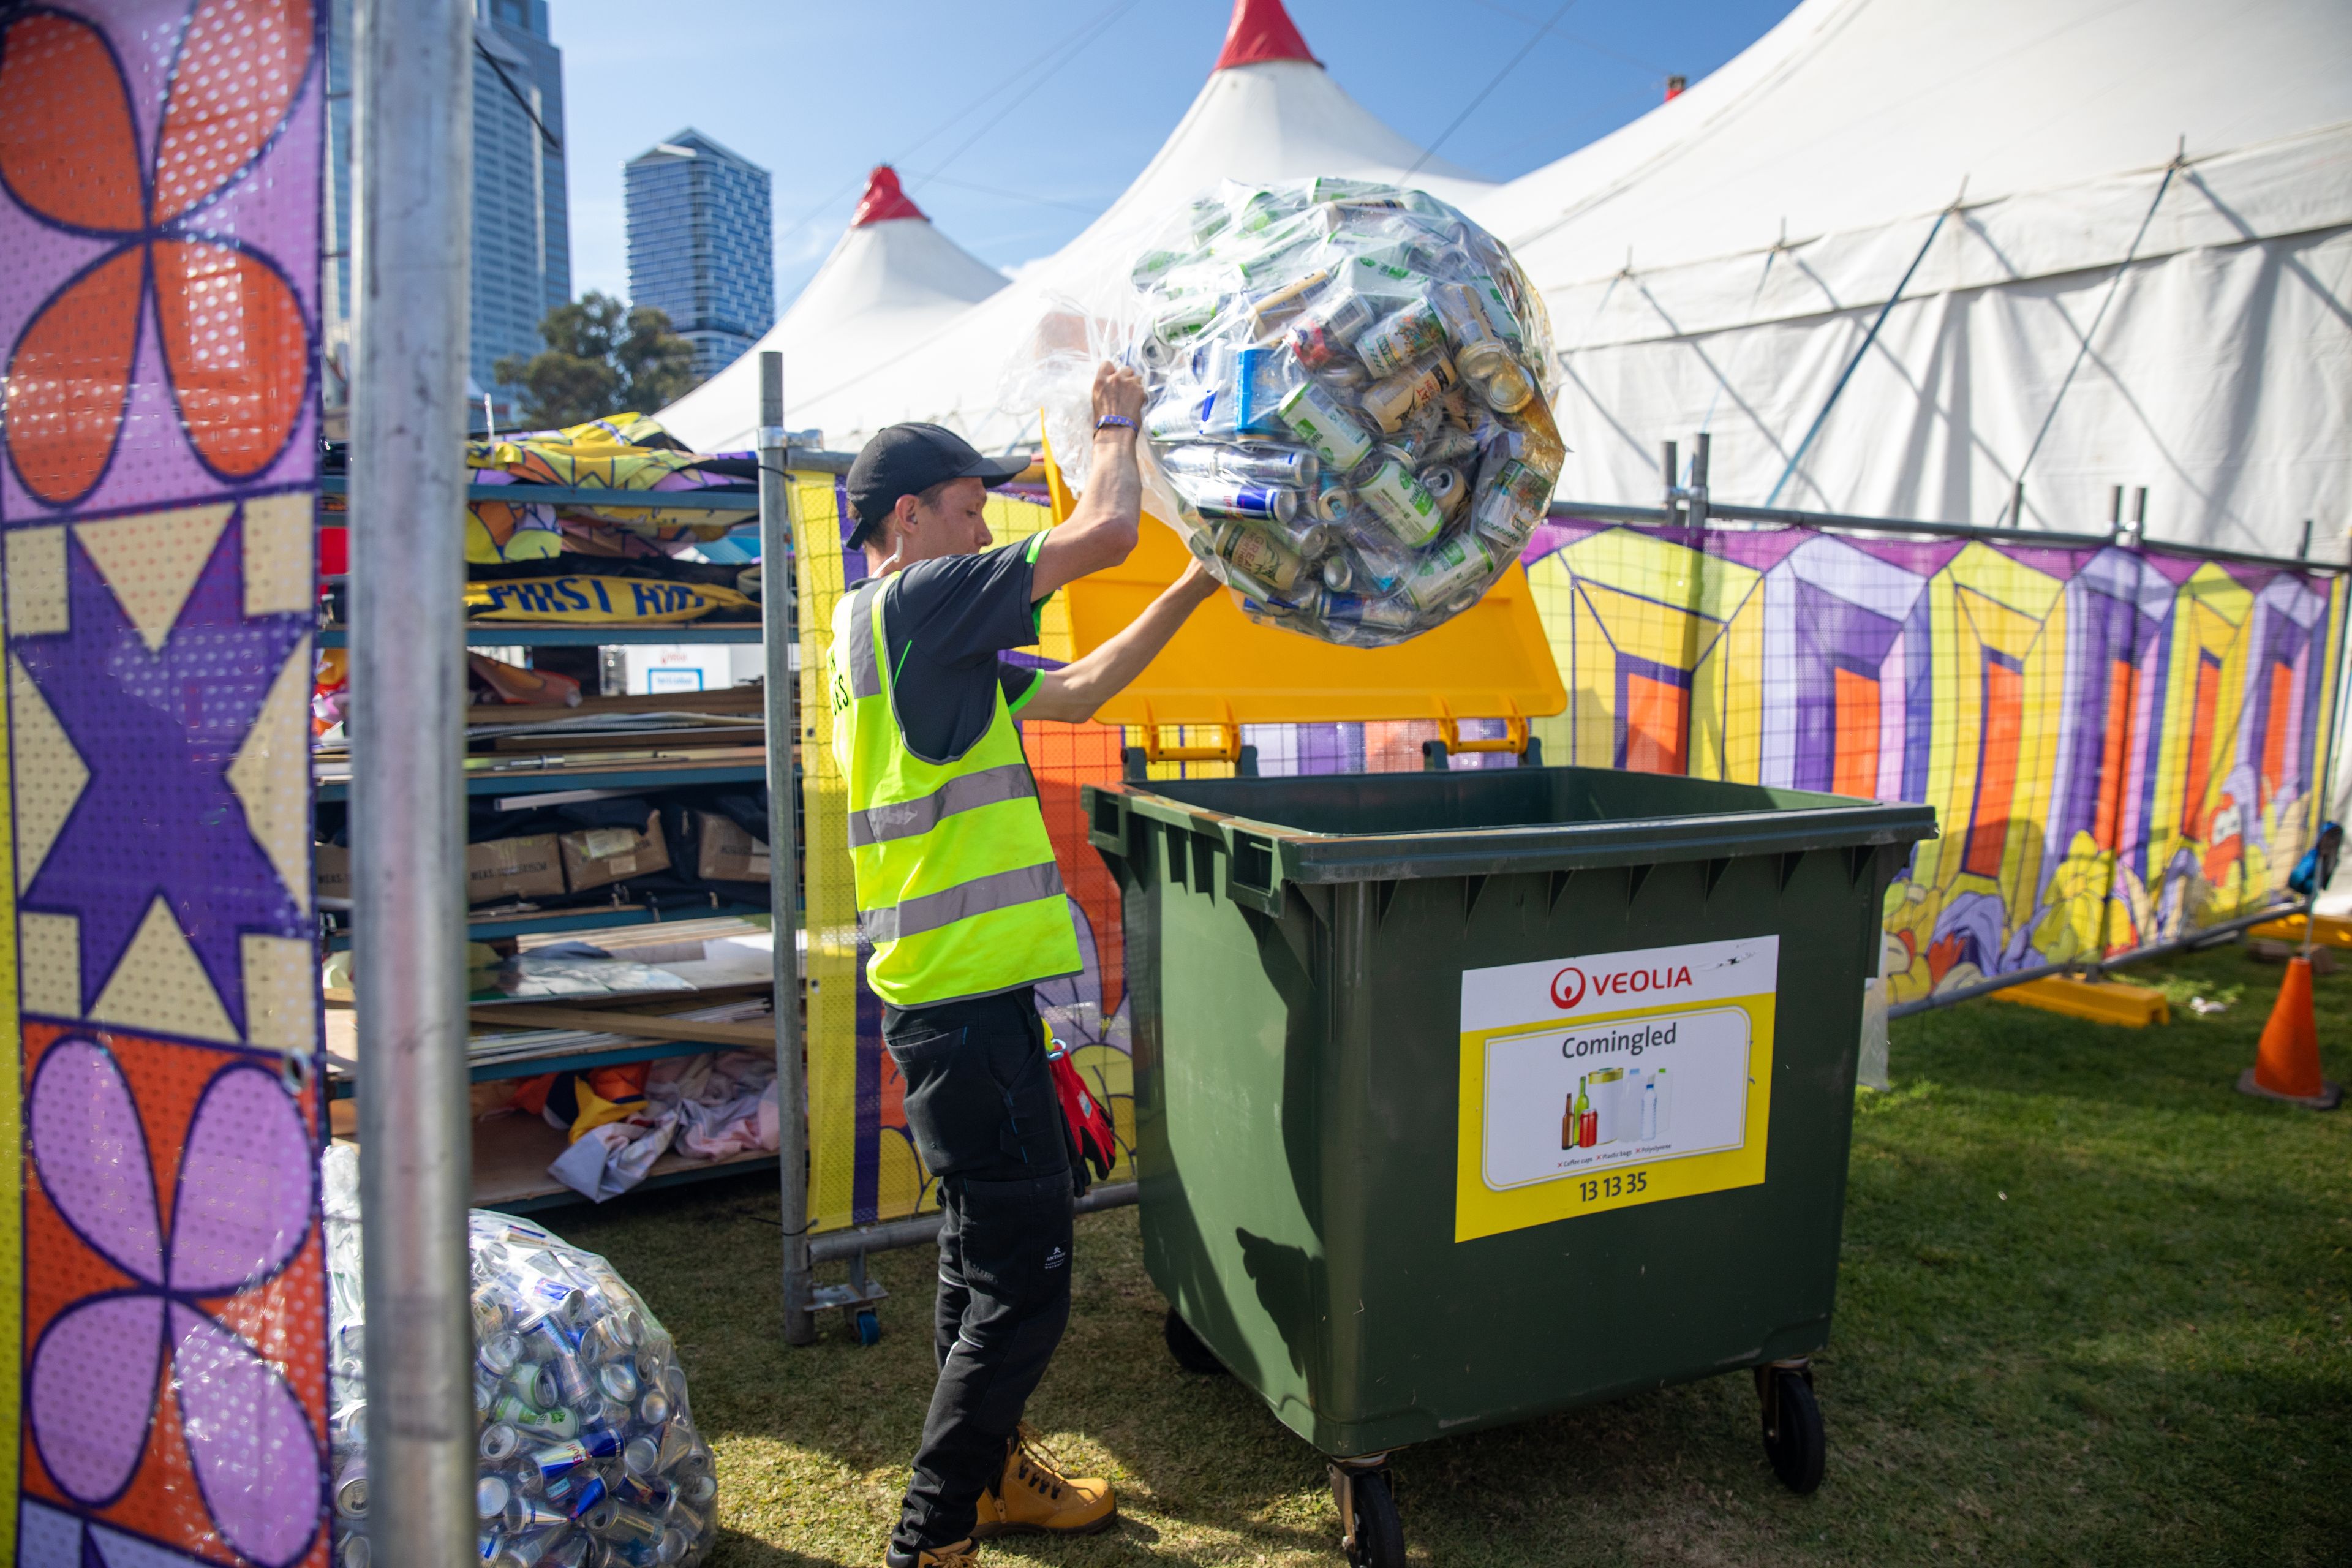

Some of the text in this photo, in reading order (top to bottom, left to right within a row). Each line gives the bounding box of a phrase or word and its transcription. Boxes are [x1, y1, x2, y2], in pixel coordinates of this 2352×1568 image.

[1593, 966, 1692, 996] VEOLIA
[1562, 1022, 1676, 1058] Comingled
[1564, 1158, 1580, 1167] Coffee
[1581, 1157, 1593, 1166] cups
[1642, 1144, 1672, 1153] Polystyrene
[1580, 1172, 1647, 1202] 13 13 35
[565, 1443, 584, 1465] Bull
